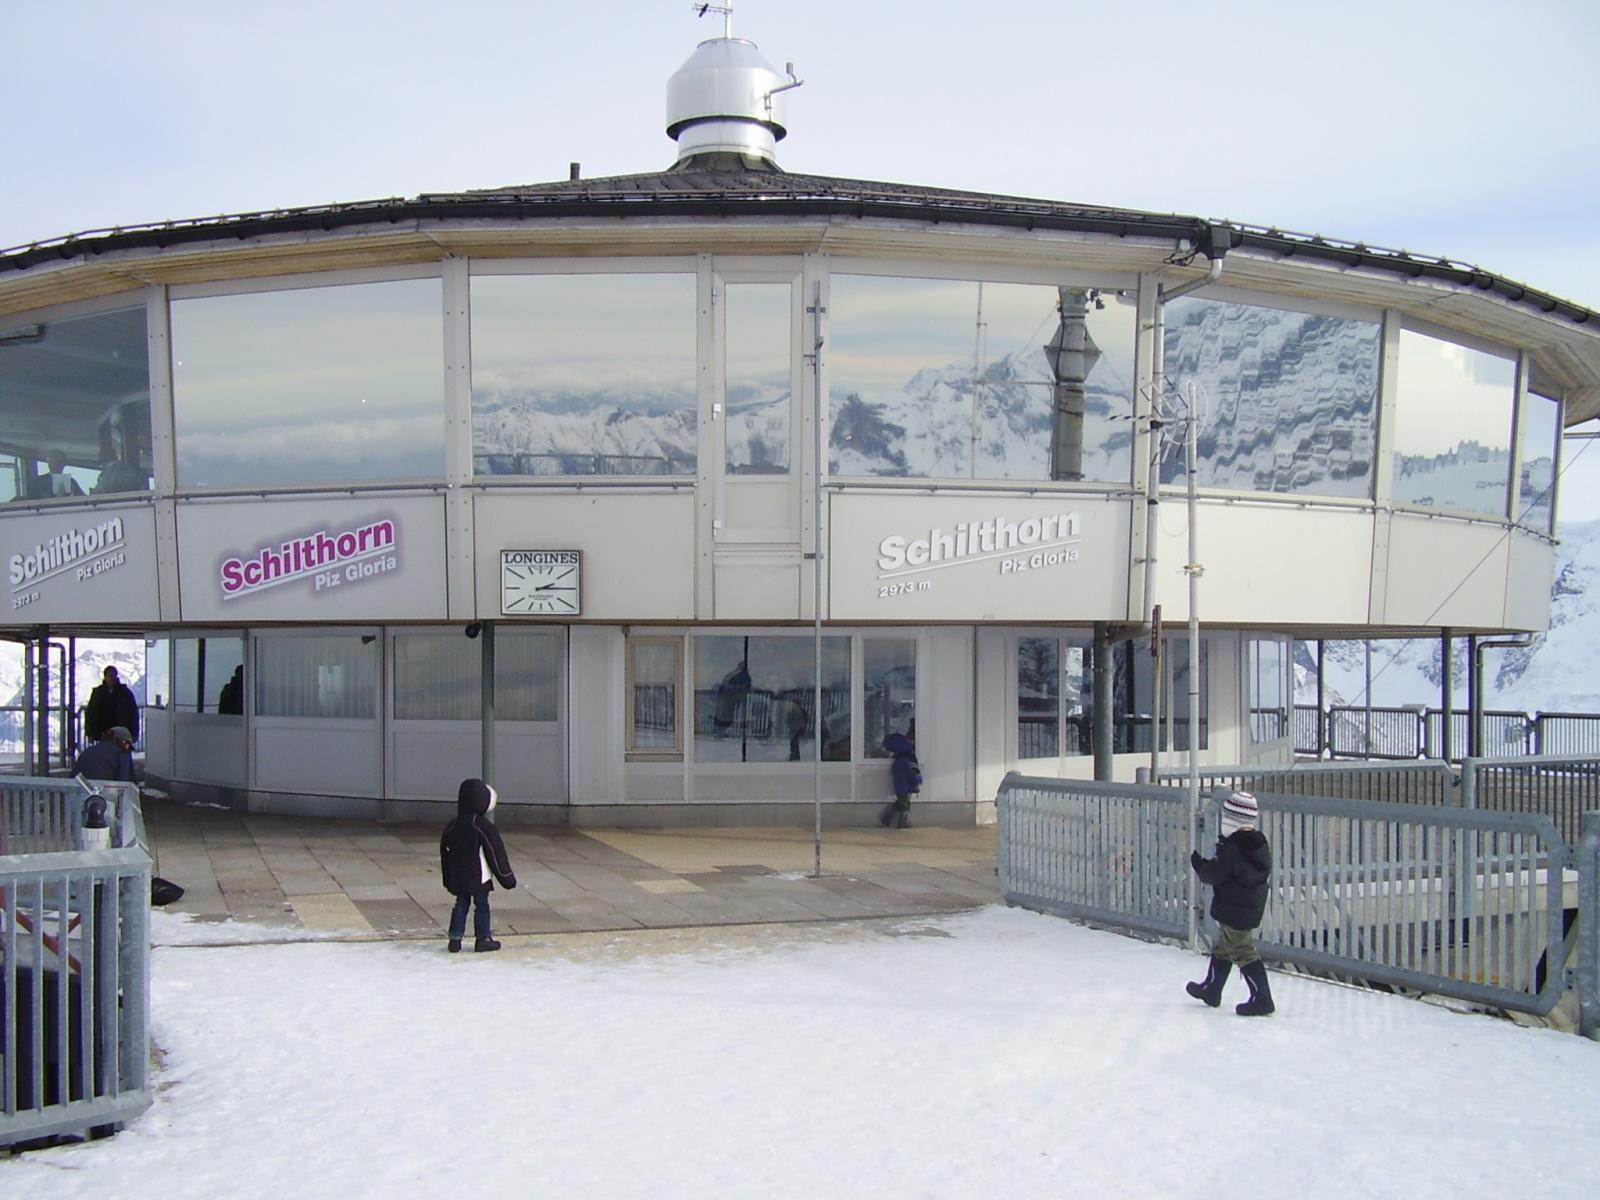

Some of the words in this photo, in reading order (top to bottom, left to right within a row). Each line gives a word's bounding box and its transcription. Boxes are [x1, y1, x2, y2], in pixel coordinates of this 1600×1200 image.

[10, 517, 124, 585] Schilthorn
[877, 511, 1080, 570] Schilthorn
[77, 566, 93, 582] Piz
[94, 553, 125, 574] Gloria
[221, 519, 394, 593] Schilthorn
[504, 553, 578, 564] LONGINES
[1000, 559, 1026, 575] Piz
[1029, 548, 1079, 569] Gloria
[315, 572, 341, 591] Piz
[345, 556, 397, 582] Gloria
[13, 594, 30, 610] 2973
[31, 591, 40, 601] m
[879, 581, 914, 598] 2973
[917, 580, 930, 591] m
